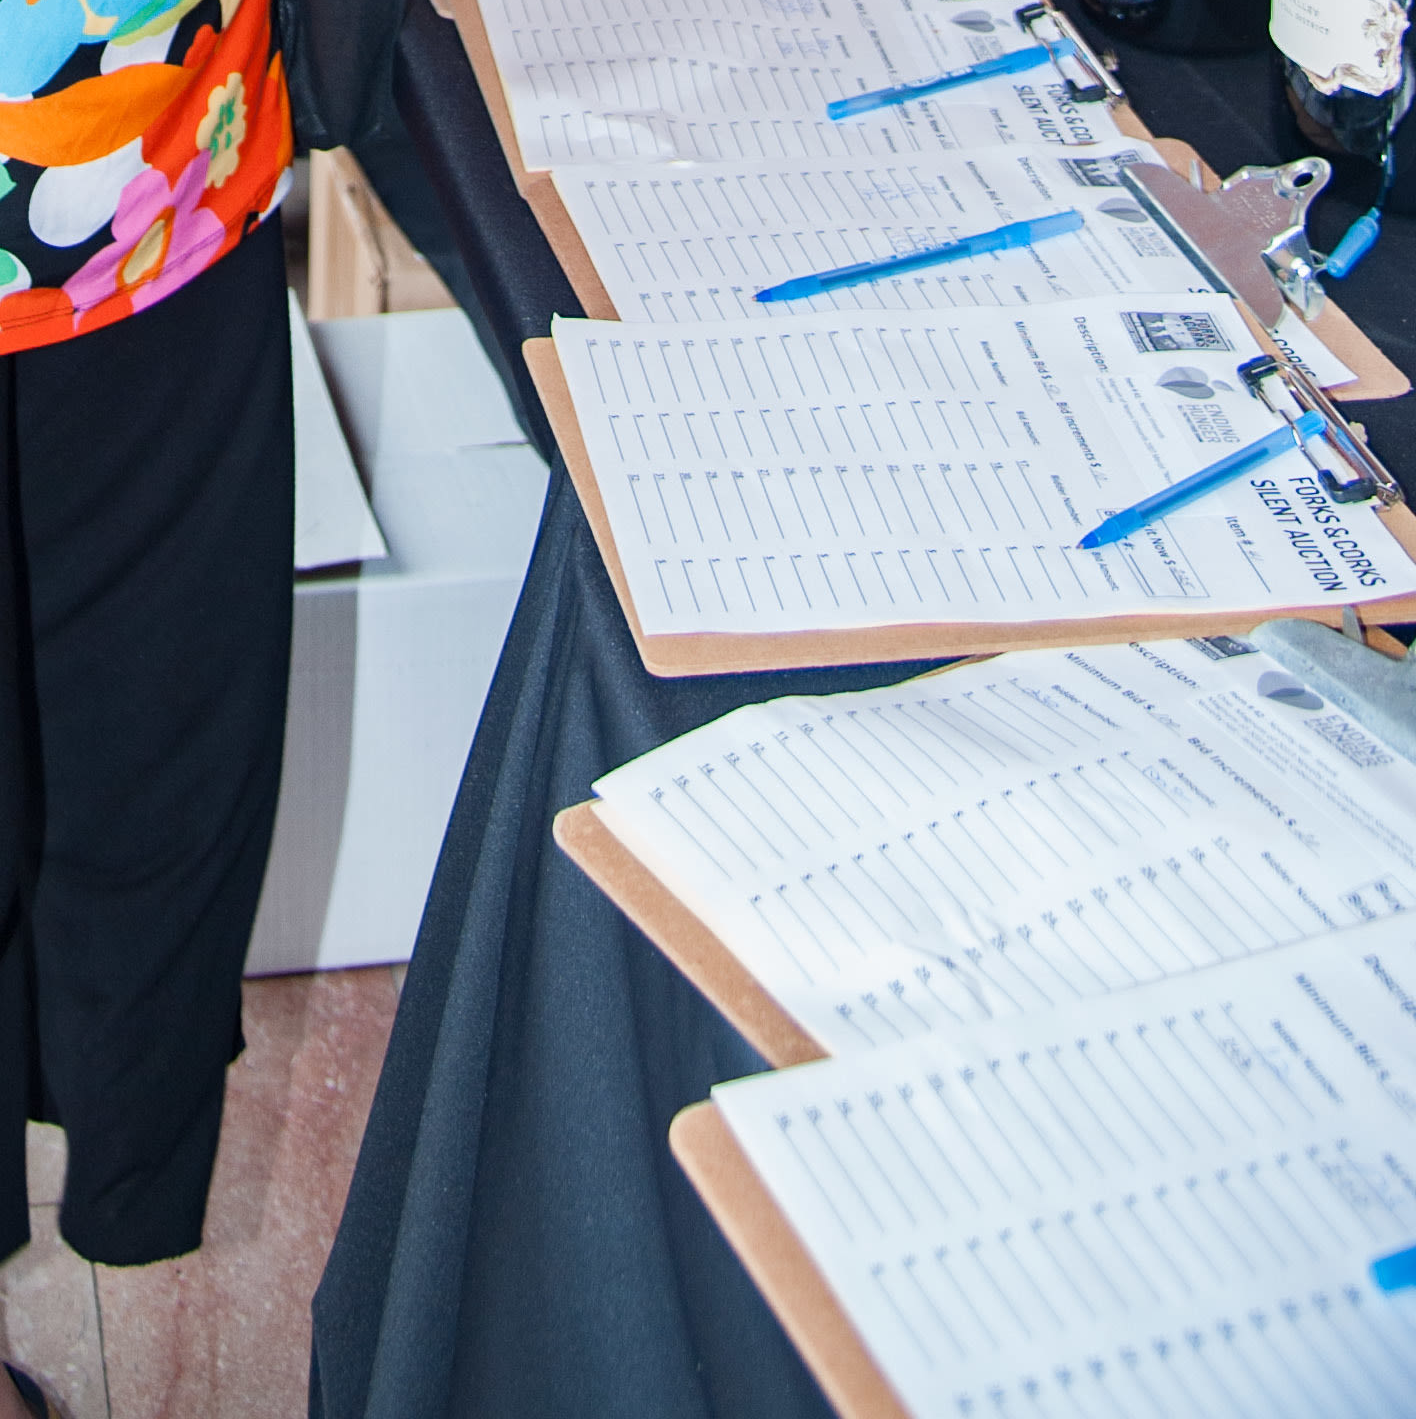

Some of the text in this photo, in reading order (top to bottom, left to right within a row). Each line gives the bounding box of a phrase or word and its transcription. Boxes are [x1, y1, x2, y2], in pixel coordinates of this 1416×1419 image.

[1012, 84, 1064, 143] SILENT AUCT
[1014, 320, 1040, 360] Minimum
[1073, 315, 1110, 374] Description:
[1033, 360, 1050, 374] Bid
[1056, 401, 1073, 415] Bid
[1184, 404, 1222, 443] HUNGER
[1204, 404, 1241, 443] ENDING
[1064, 415, 1096, 461] Increments
[1151, 536, 1170, 558] Now
[1224, 515, 1250, 542] Item
[1249, 478, 1349, 592] SILENT AUCTION
[1288, 476, 1387, 587] FORKS & CORKS
[1129, 641, 1200, 690] escription:
[1064, 652, 1122, 691] Minimum
[1122, 689, 1148, 704] Bid
[1187, 736, 1214, 756] Bid
[1209, 755, 1285, 819] Increments
[1326, 714, 1394, 764] ENDING
